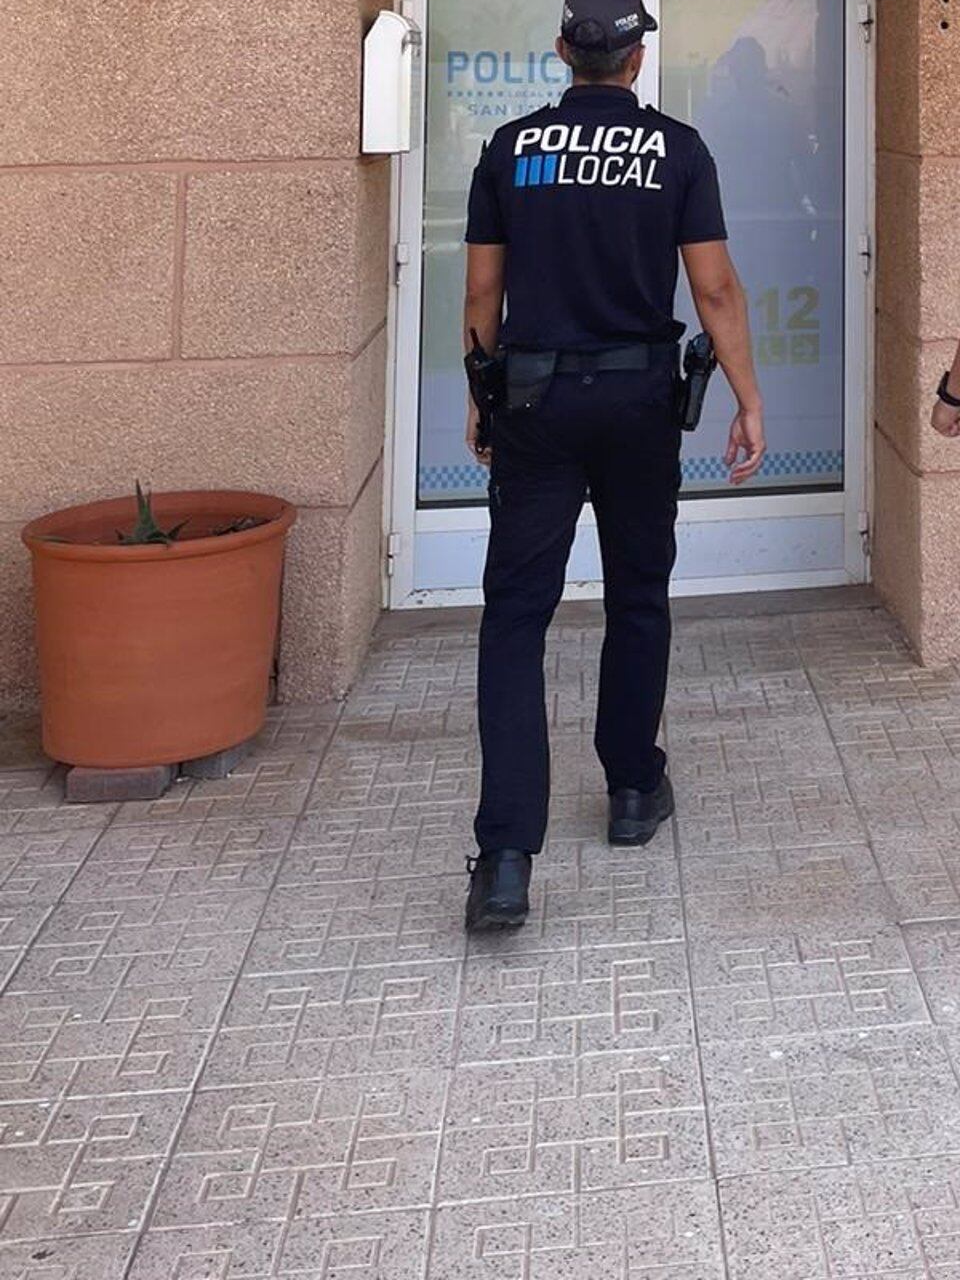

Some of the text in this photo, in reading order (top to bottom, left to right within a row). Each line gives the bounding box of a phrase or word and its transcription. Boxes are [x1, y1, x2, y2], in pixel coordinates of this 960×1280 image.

[514, 124, 667, 157] POLICIA
[558, 154, 663, 190] LOCAL
[755, 285, 821, 332] 12
